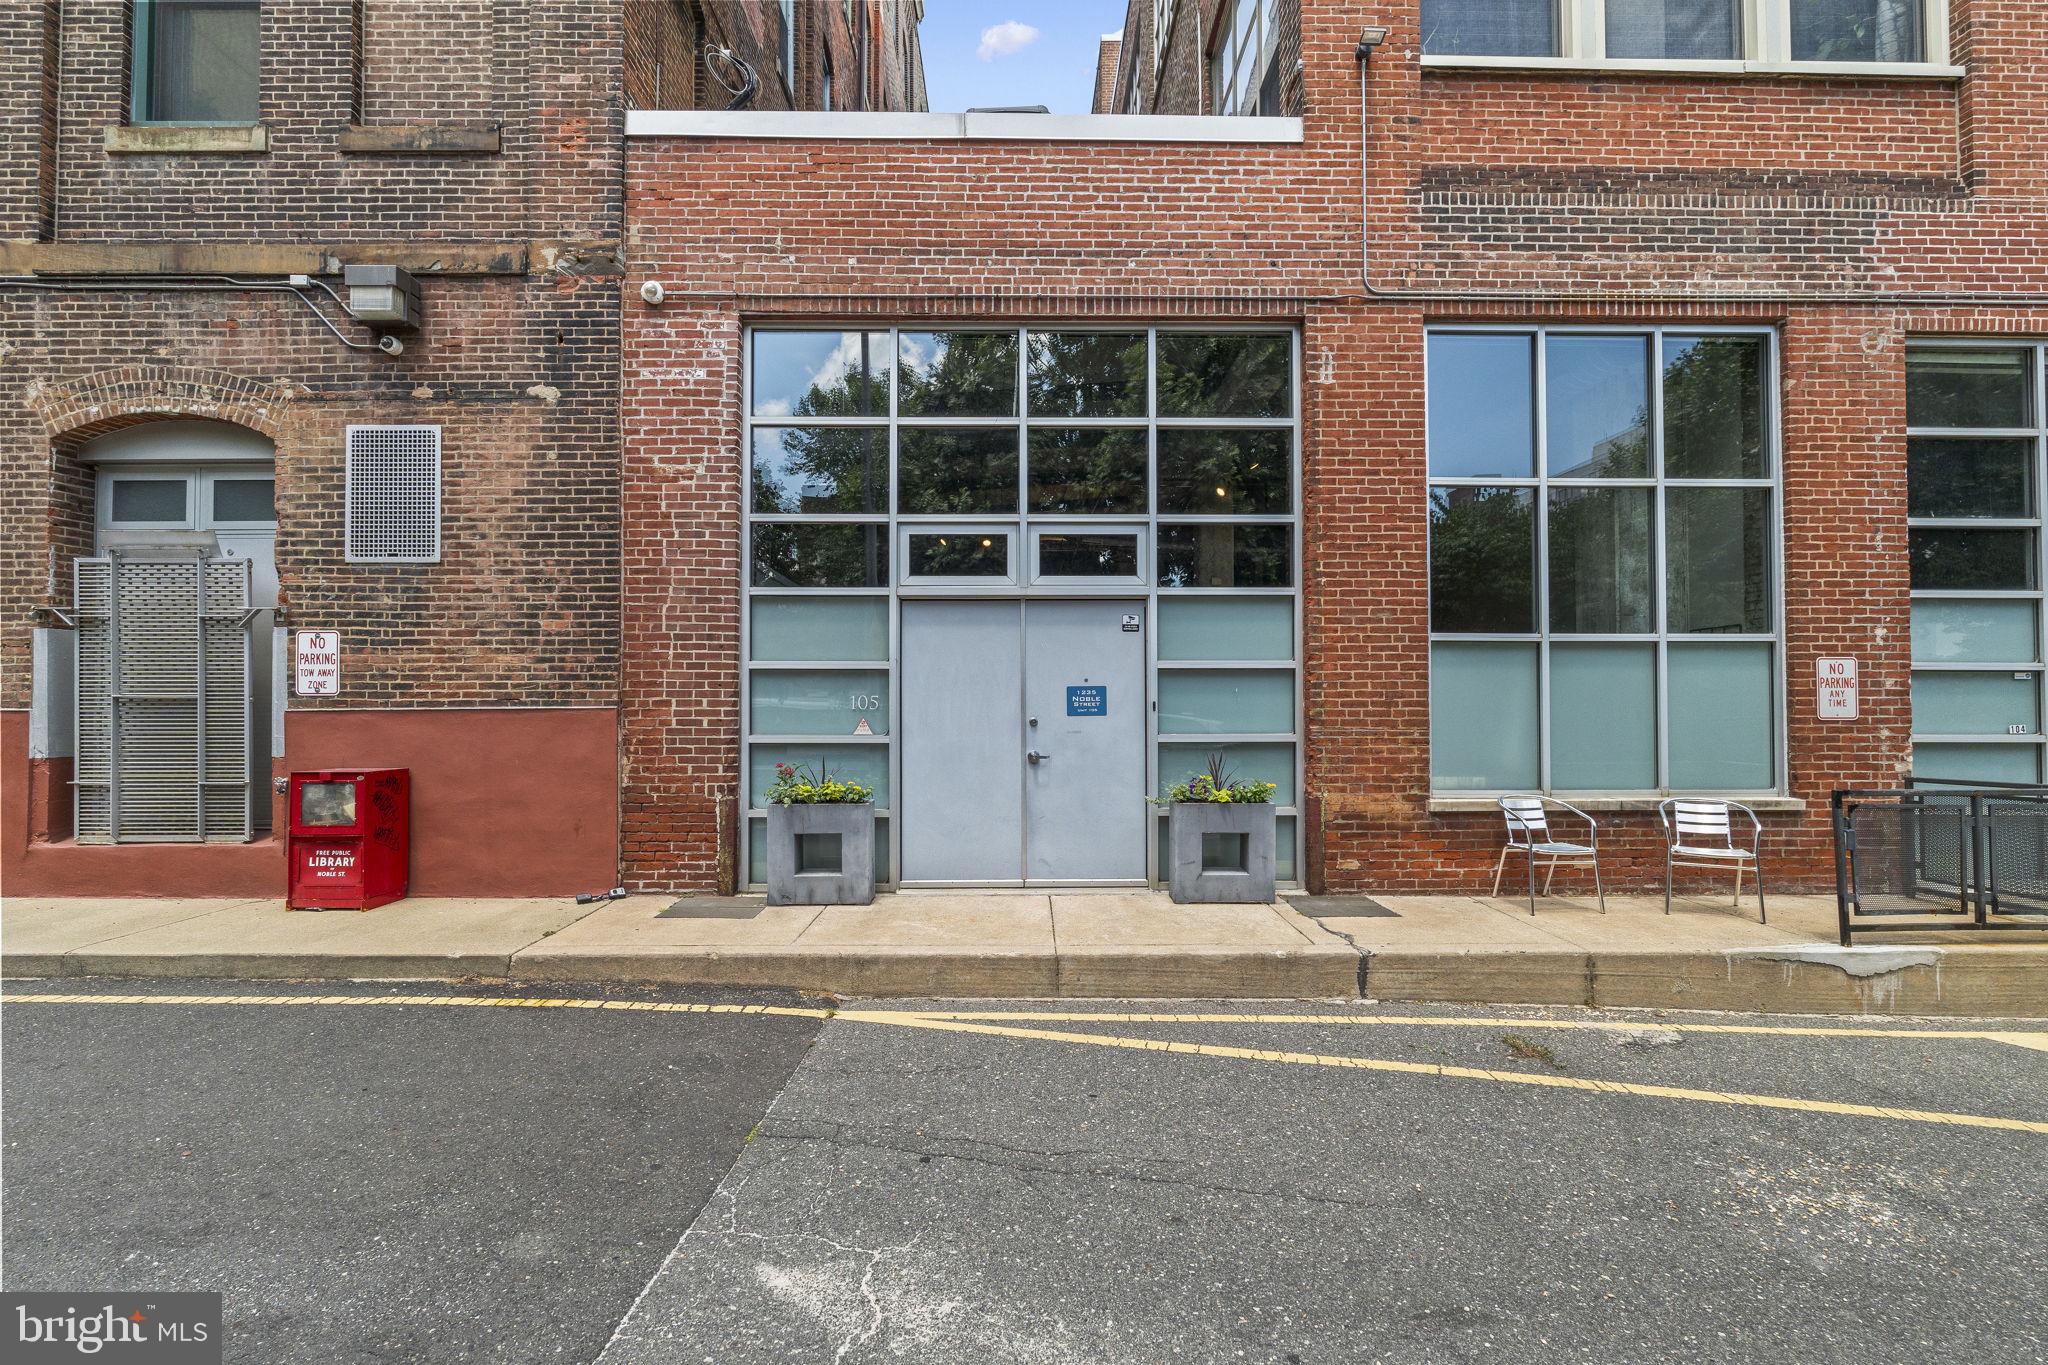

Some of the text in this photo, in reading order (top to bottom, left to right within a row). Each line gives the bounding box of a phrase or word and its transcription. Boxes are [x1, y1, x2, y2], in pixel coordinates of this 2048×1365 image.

[310, 637, 326, 649] NO
[299, 653, 336, 665] PARKING
[300, 668, 336, 677] TOW AWAY
[1829, 663, 1844, 675] NO
[307, 680, 328, 689] ZONE
[1820, 677, 1855, 689] PARKING
[1829, 690, 1845, 698] ANY
[851, 694, 879, 710] 105
[1828, 699, 1848, 707] TIME
[2010, 725, 2026, 734] 104
[308, 857, 355, 867] LIBRARY
